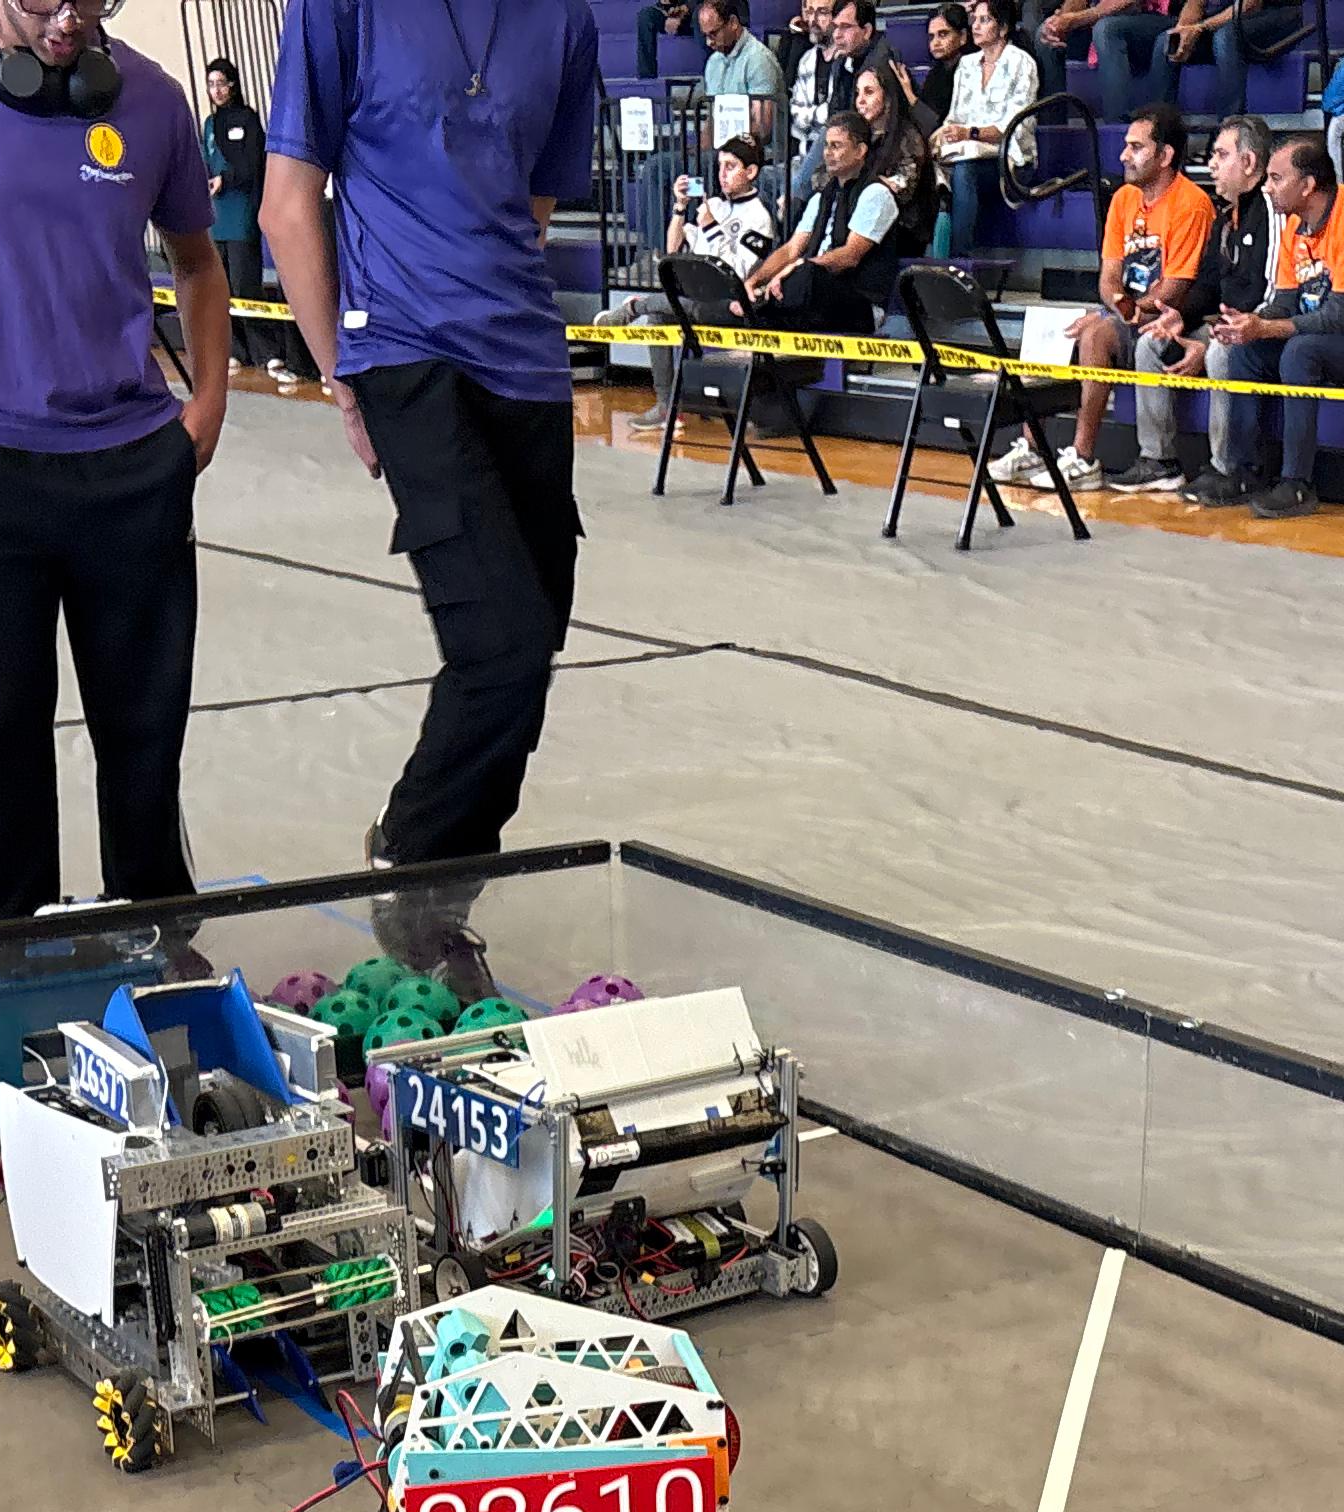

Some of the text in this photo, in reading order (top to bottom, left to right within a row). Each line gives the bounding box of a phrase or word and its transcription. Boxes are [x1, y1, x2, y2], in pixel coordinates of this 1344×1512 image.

[734, 332, 781, 348] CAUTION
[794, 337, 844, 354] CAUTION
[857, 341, 912, 358] CAUTION
[74, 1044, 129, 1121] 26372
[408, 1074, 509, 1161] 24153
